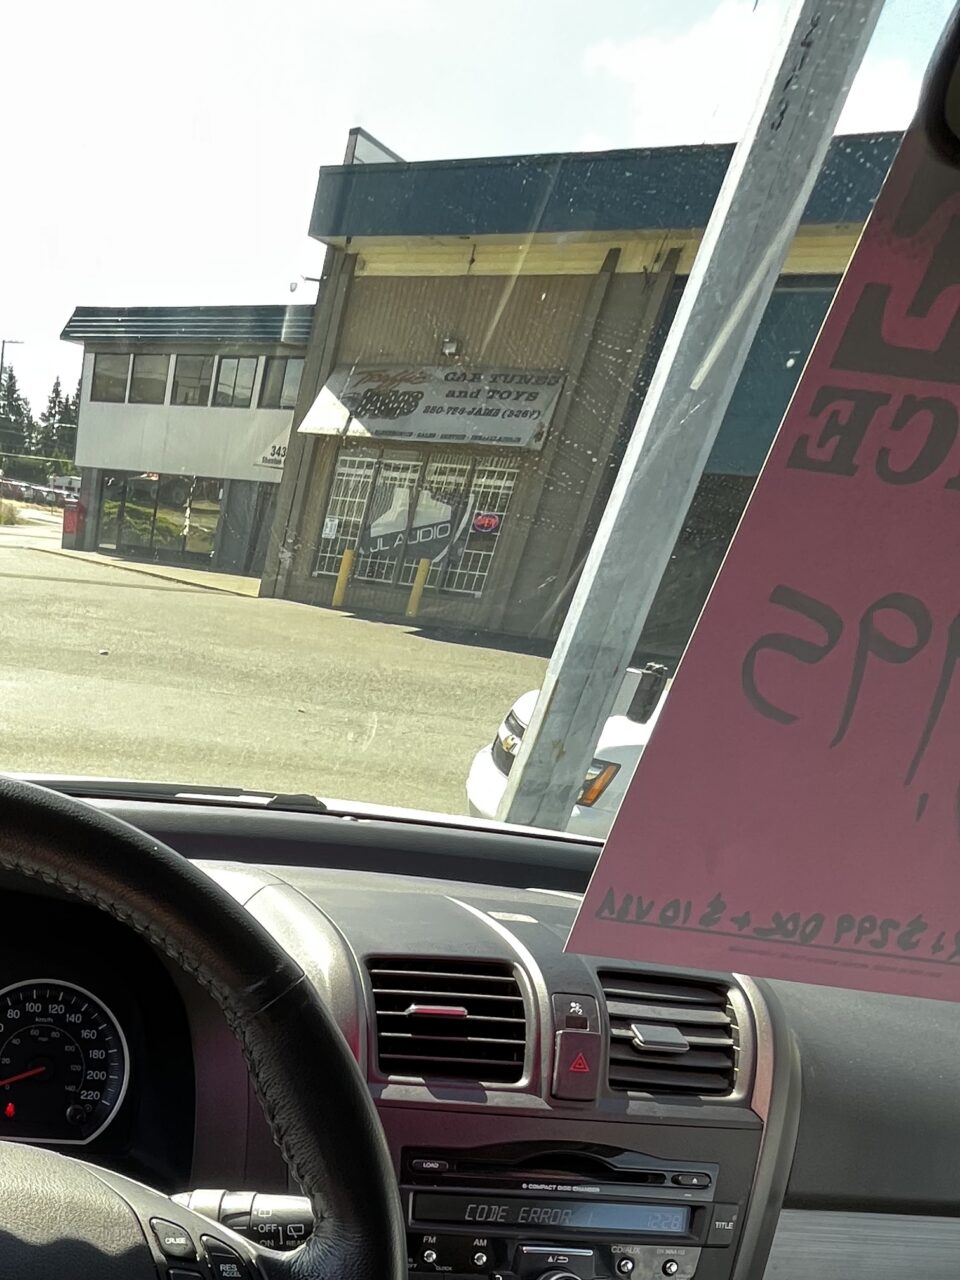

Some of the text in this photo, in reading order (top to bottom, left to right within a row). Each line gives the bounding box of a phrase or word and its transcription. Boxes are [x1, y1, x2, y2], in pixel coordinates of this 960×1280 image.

[444, 371, 561, 386] CAR TUNES
[446, 389, 539, 402] and TOYS
[370, 523, 451, 553] JL AUDIO
[25, 1002, 42, 1013] 100
[48, 1004, 65, 1014] 120
[7, 1009, 20, 1019] 80
[66, 1013, 82, 1024] 140
[81, 1029, 97, 1039] 160
[89, 1050, 106, 1059] 180
[86, 1070, 107, 1080] 200
[80, 1090, 100, 1100] 220
[465, 1204, 572, 1225] CODE ERROR
[258, 1224, 278, 1233] OFF
[715, 1221, 733, 1229] TITLE
[259, 1239, 274, 1247] ON
[473, 1239, 487, 1247] AM
